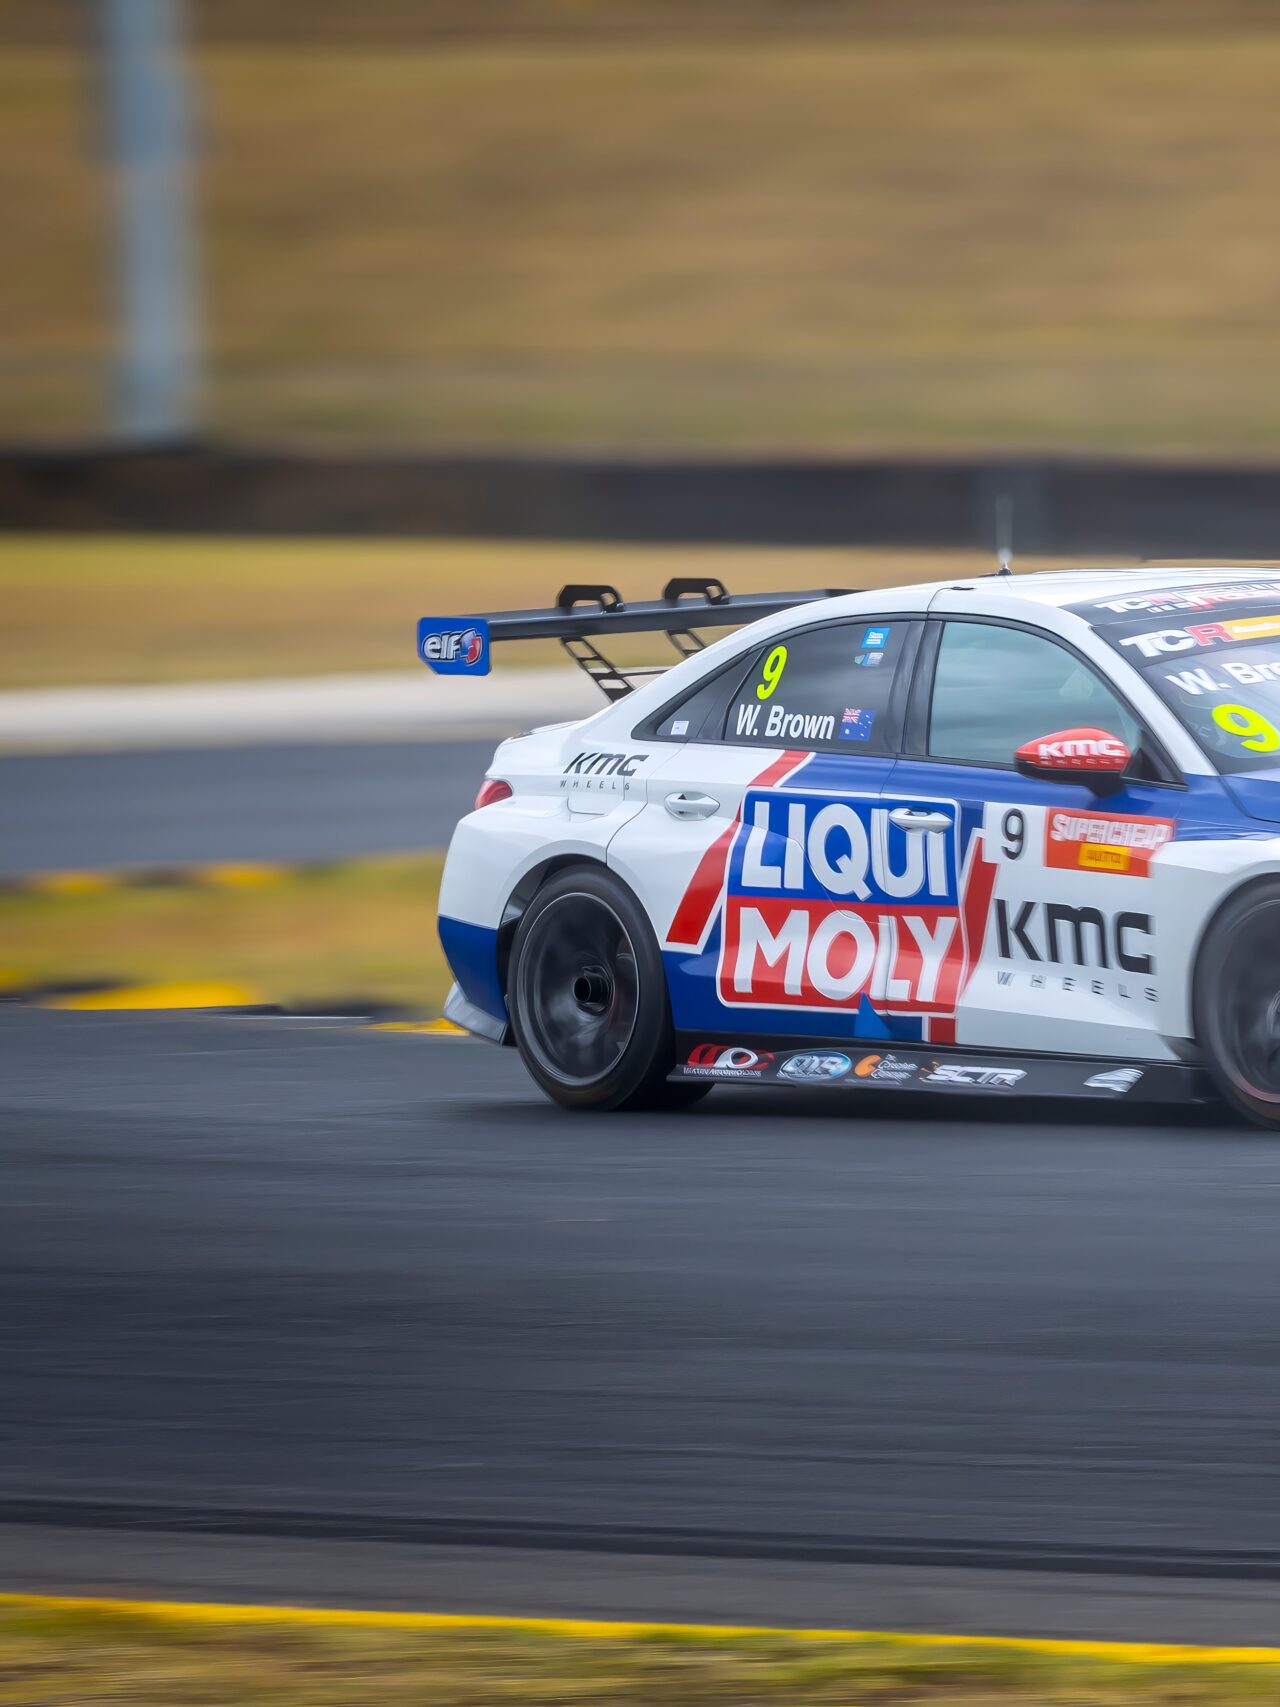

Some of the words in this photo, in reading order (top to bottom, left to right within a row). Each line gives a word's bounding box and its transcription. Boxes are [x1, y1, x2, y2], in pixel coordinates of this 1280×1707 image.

[1092, 592, 1183, 614] TCR
[422, 631, 462, 662] elf
[1119, 623, 1236, 657] TCR
[756, 645, 788, 700] 9
[1165, 667, 1233, 696] W.
[736, 704, 761, 736] W.
[764, 705, 836, 740] Brown
[559, 780, 631, 791] WHEELS
[740, 801, 949, 902] LIQUI
[1001, 808, 1025, 860] 9
[993, 898, 1158, 976] KMC
[733, 906, 959, 1004] MOLY
[996, 970, 1160, 1003] WHEELS
